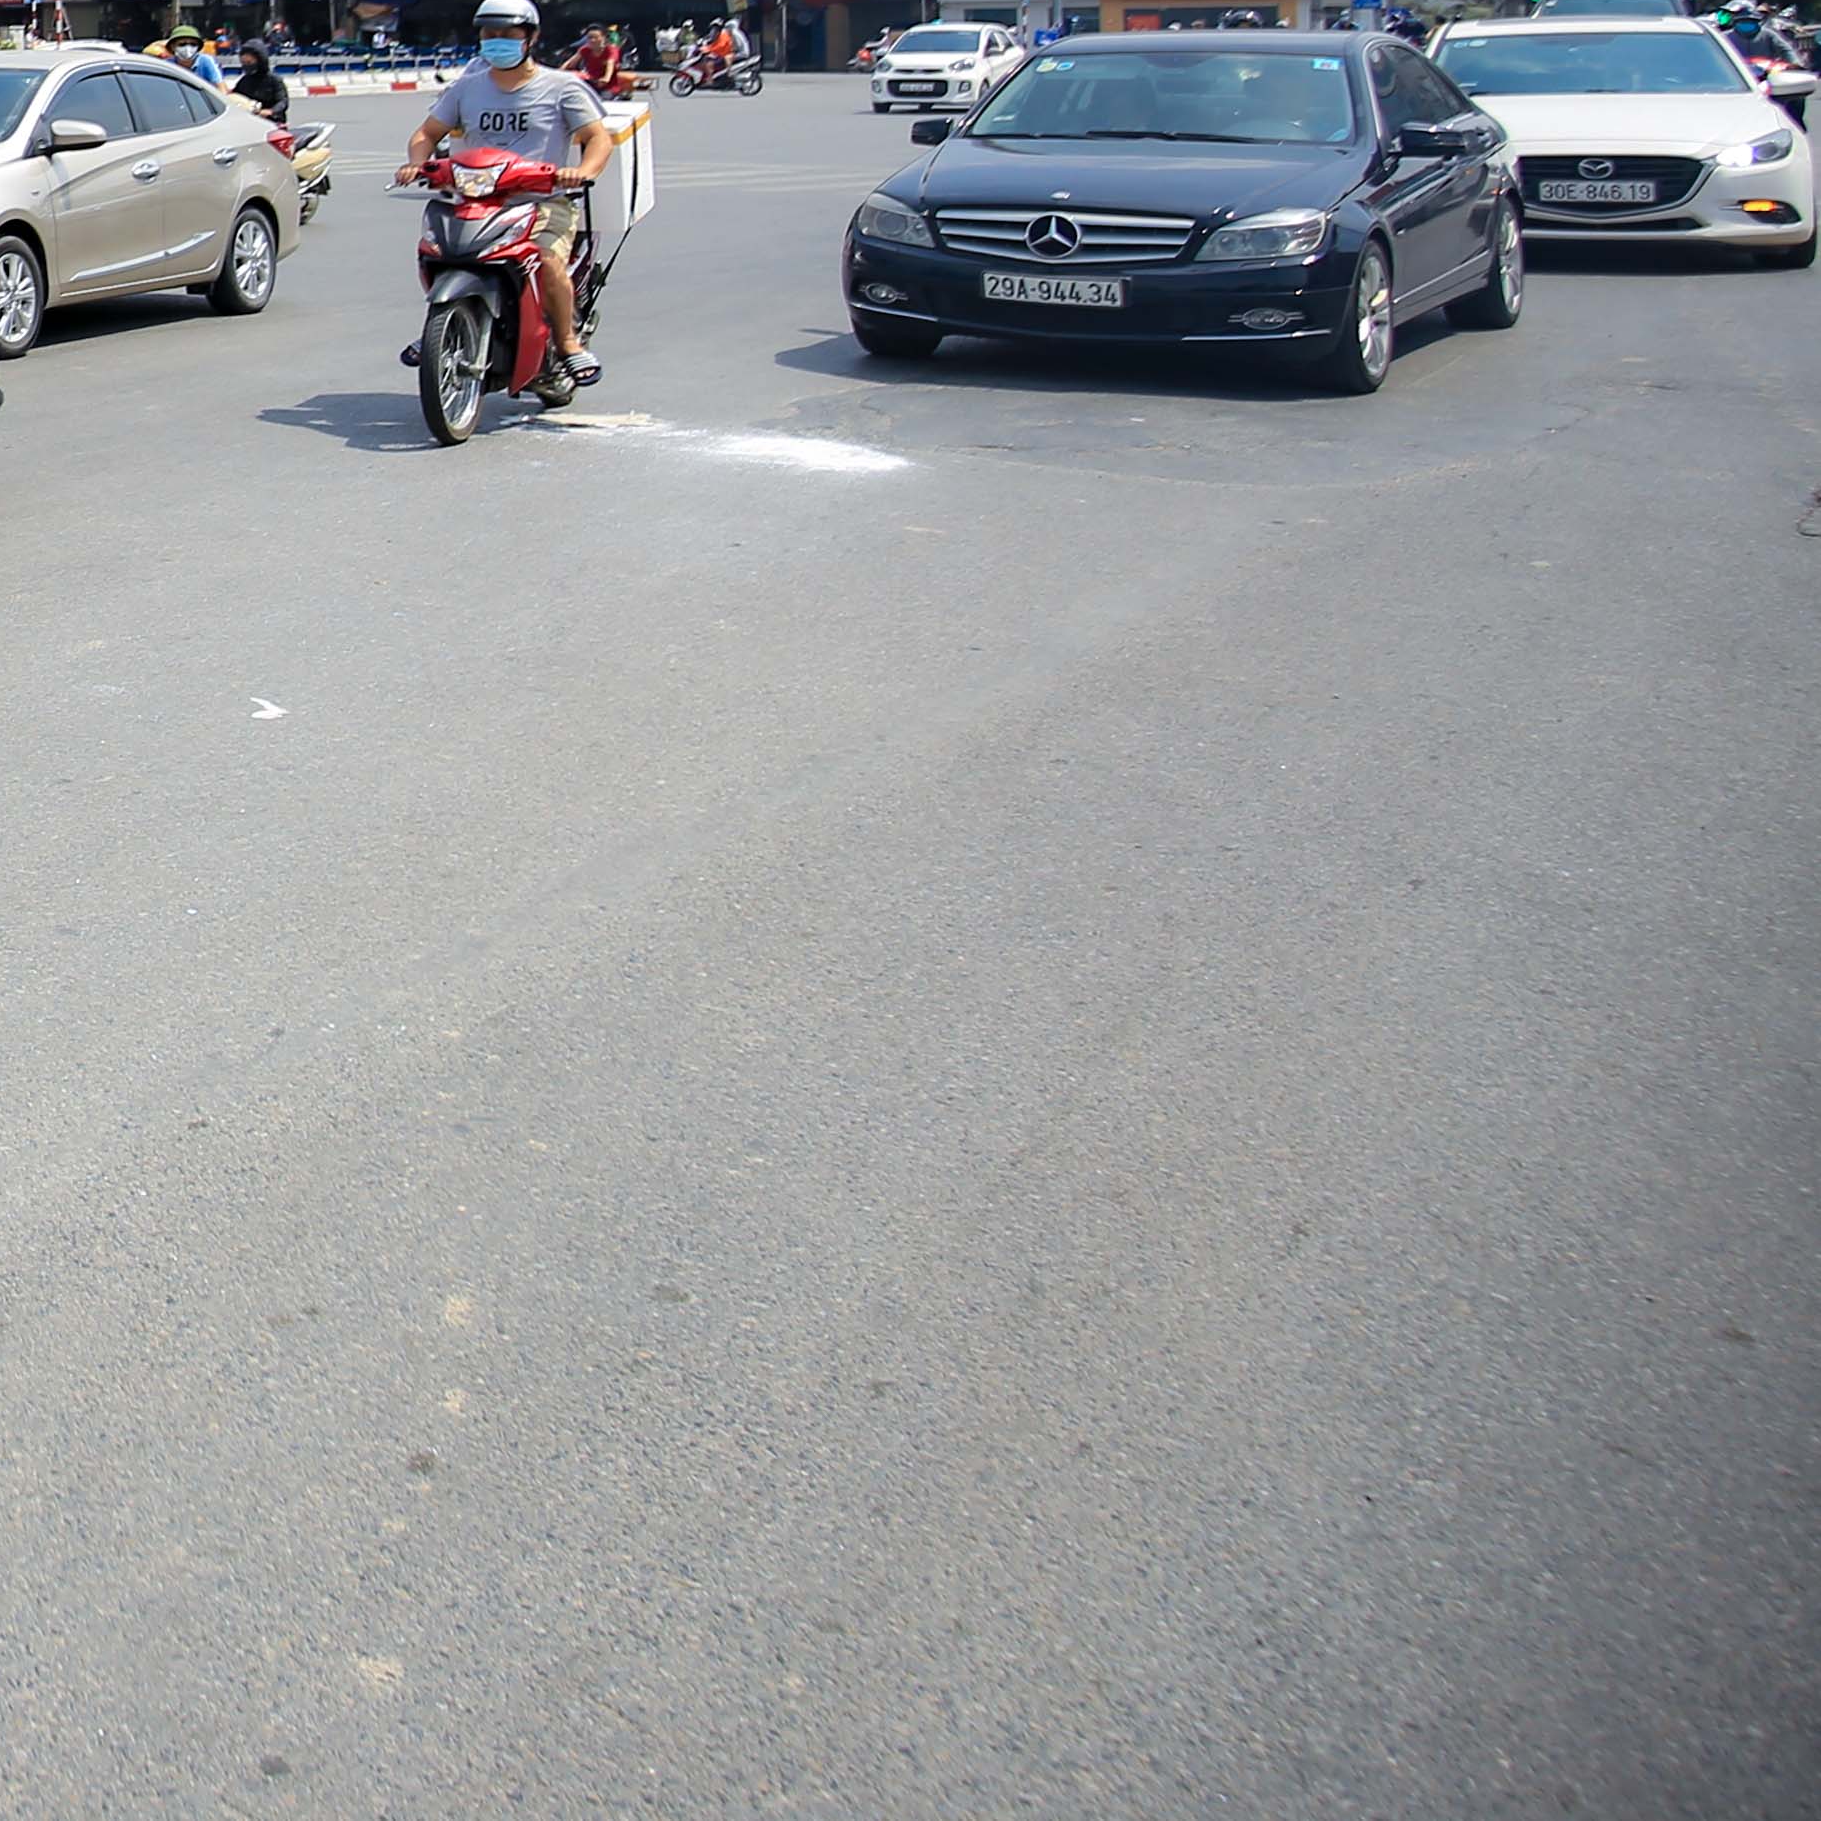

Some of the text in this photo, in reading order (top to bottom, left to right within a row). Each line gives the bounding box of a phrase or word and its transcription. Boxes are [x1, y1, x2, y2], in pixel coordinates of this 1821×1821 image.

[479, 111, 530, 132] CORE
[1542, 184, 1651, 201] 30E-846.19
[987, 276, 1118, 304] 29A-944.34
